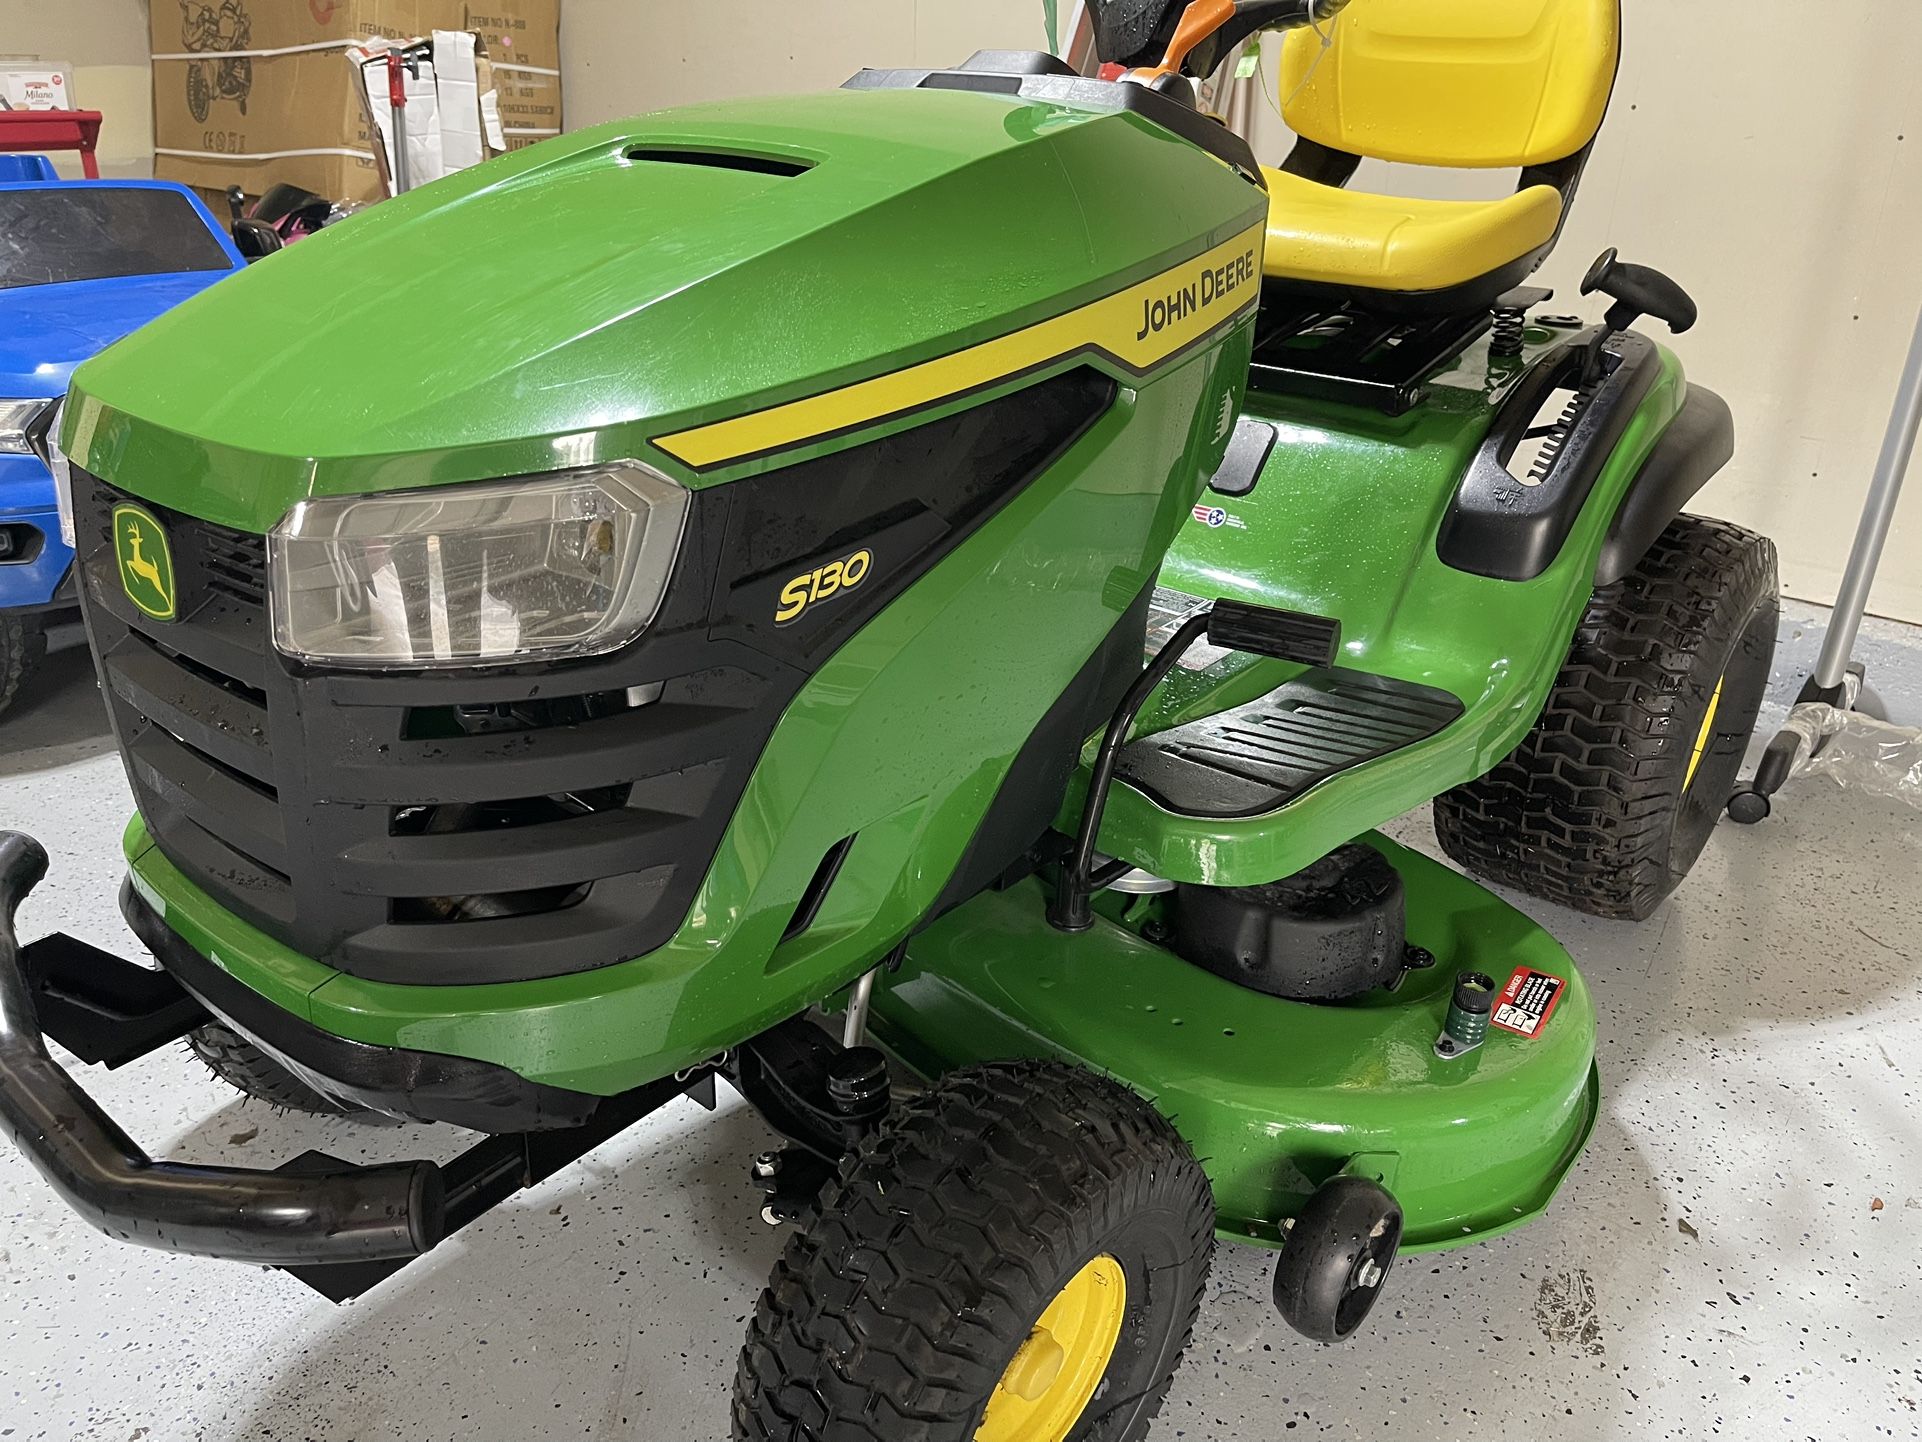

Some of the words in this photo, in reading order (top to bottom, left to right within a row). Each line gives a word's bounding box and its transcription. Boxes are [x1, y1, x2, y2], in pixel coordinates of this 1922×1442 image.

[470, 16, 489, 27] ITEM
[360, 23, 381, 35] ITEM
[24, 90, 54, 101] Milano
[1136, 283, 1197, 341] JOHN
[1201, 249, 1254, 307] DEERE
[775, 550, 870, 622] S130
